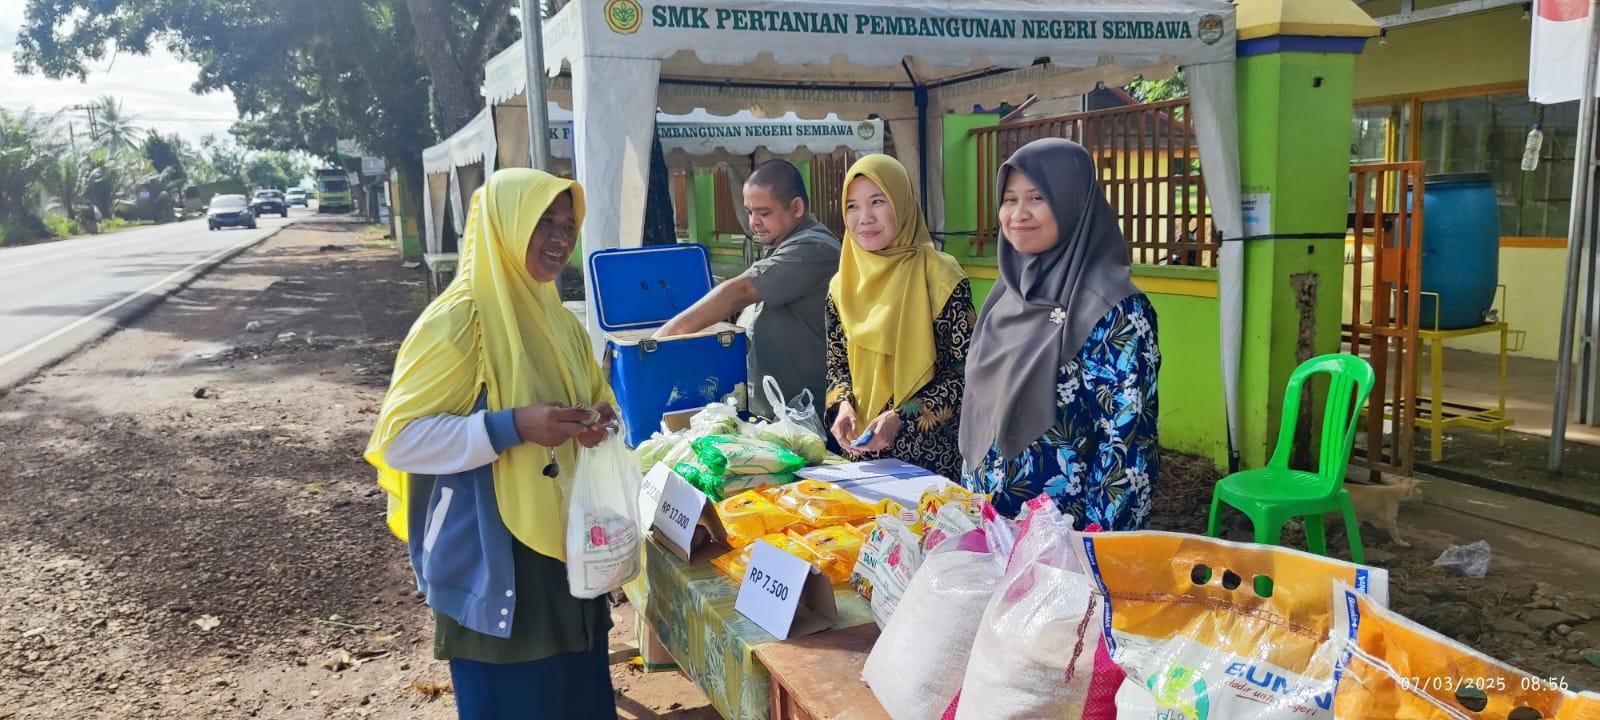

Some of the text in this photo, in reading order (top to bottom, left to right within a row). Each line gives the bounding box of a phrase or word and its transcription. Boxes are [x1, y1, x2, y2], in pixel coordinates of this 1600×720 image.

[652, 5, 1192, 39] SMK PERTANIAN PEMBANGUNAN NEGERI SEMBAWA
[657, 125, 853, 138] MBANGUNAN NEGERI SEMBAWA
[661, 501, 690, 530] RP 17.000
[749, 566, 789, 601] RP 7.500
